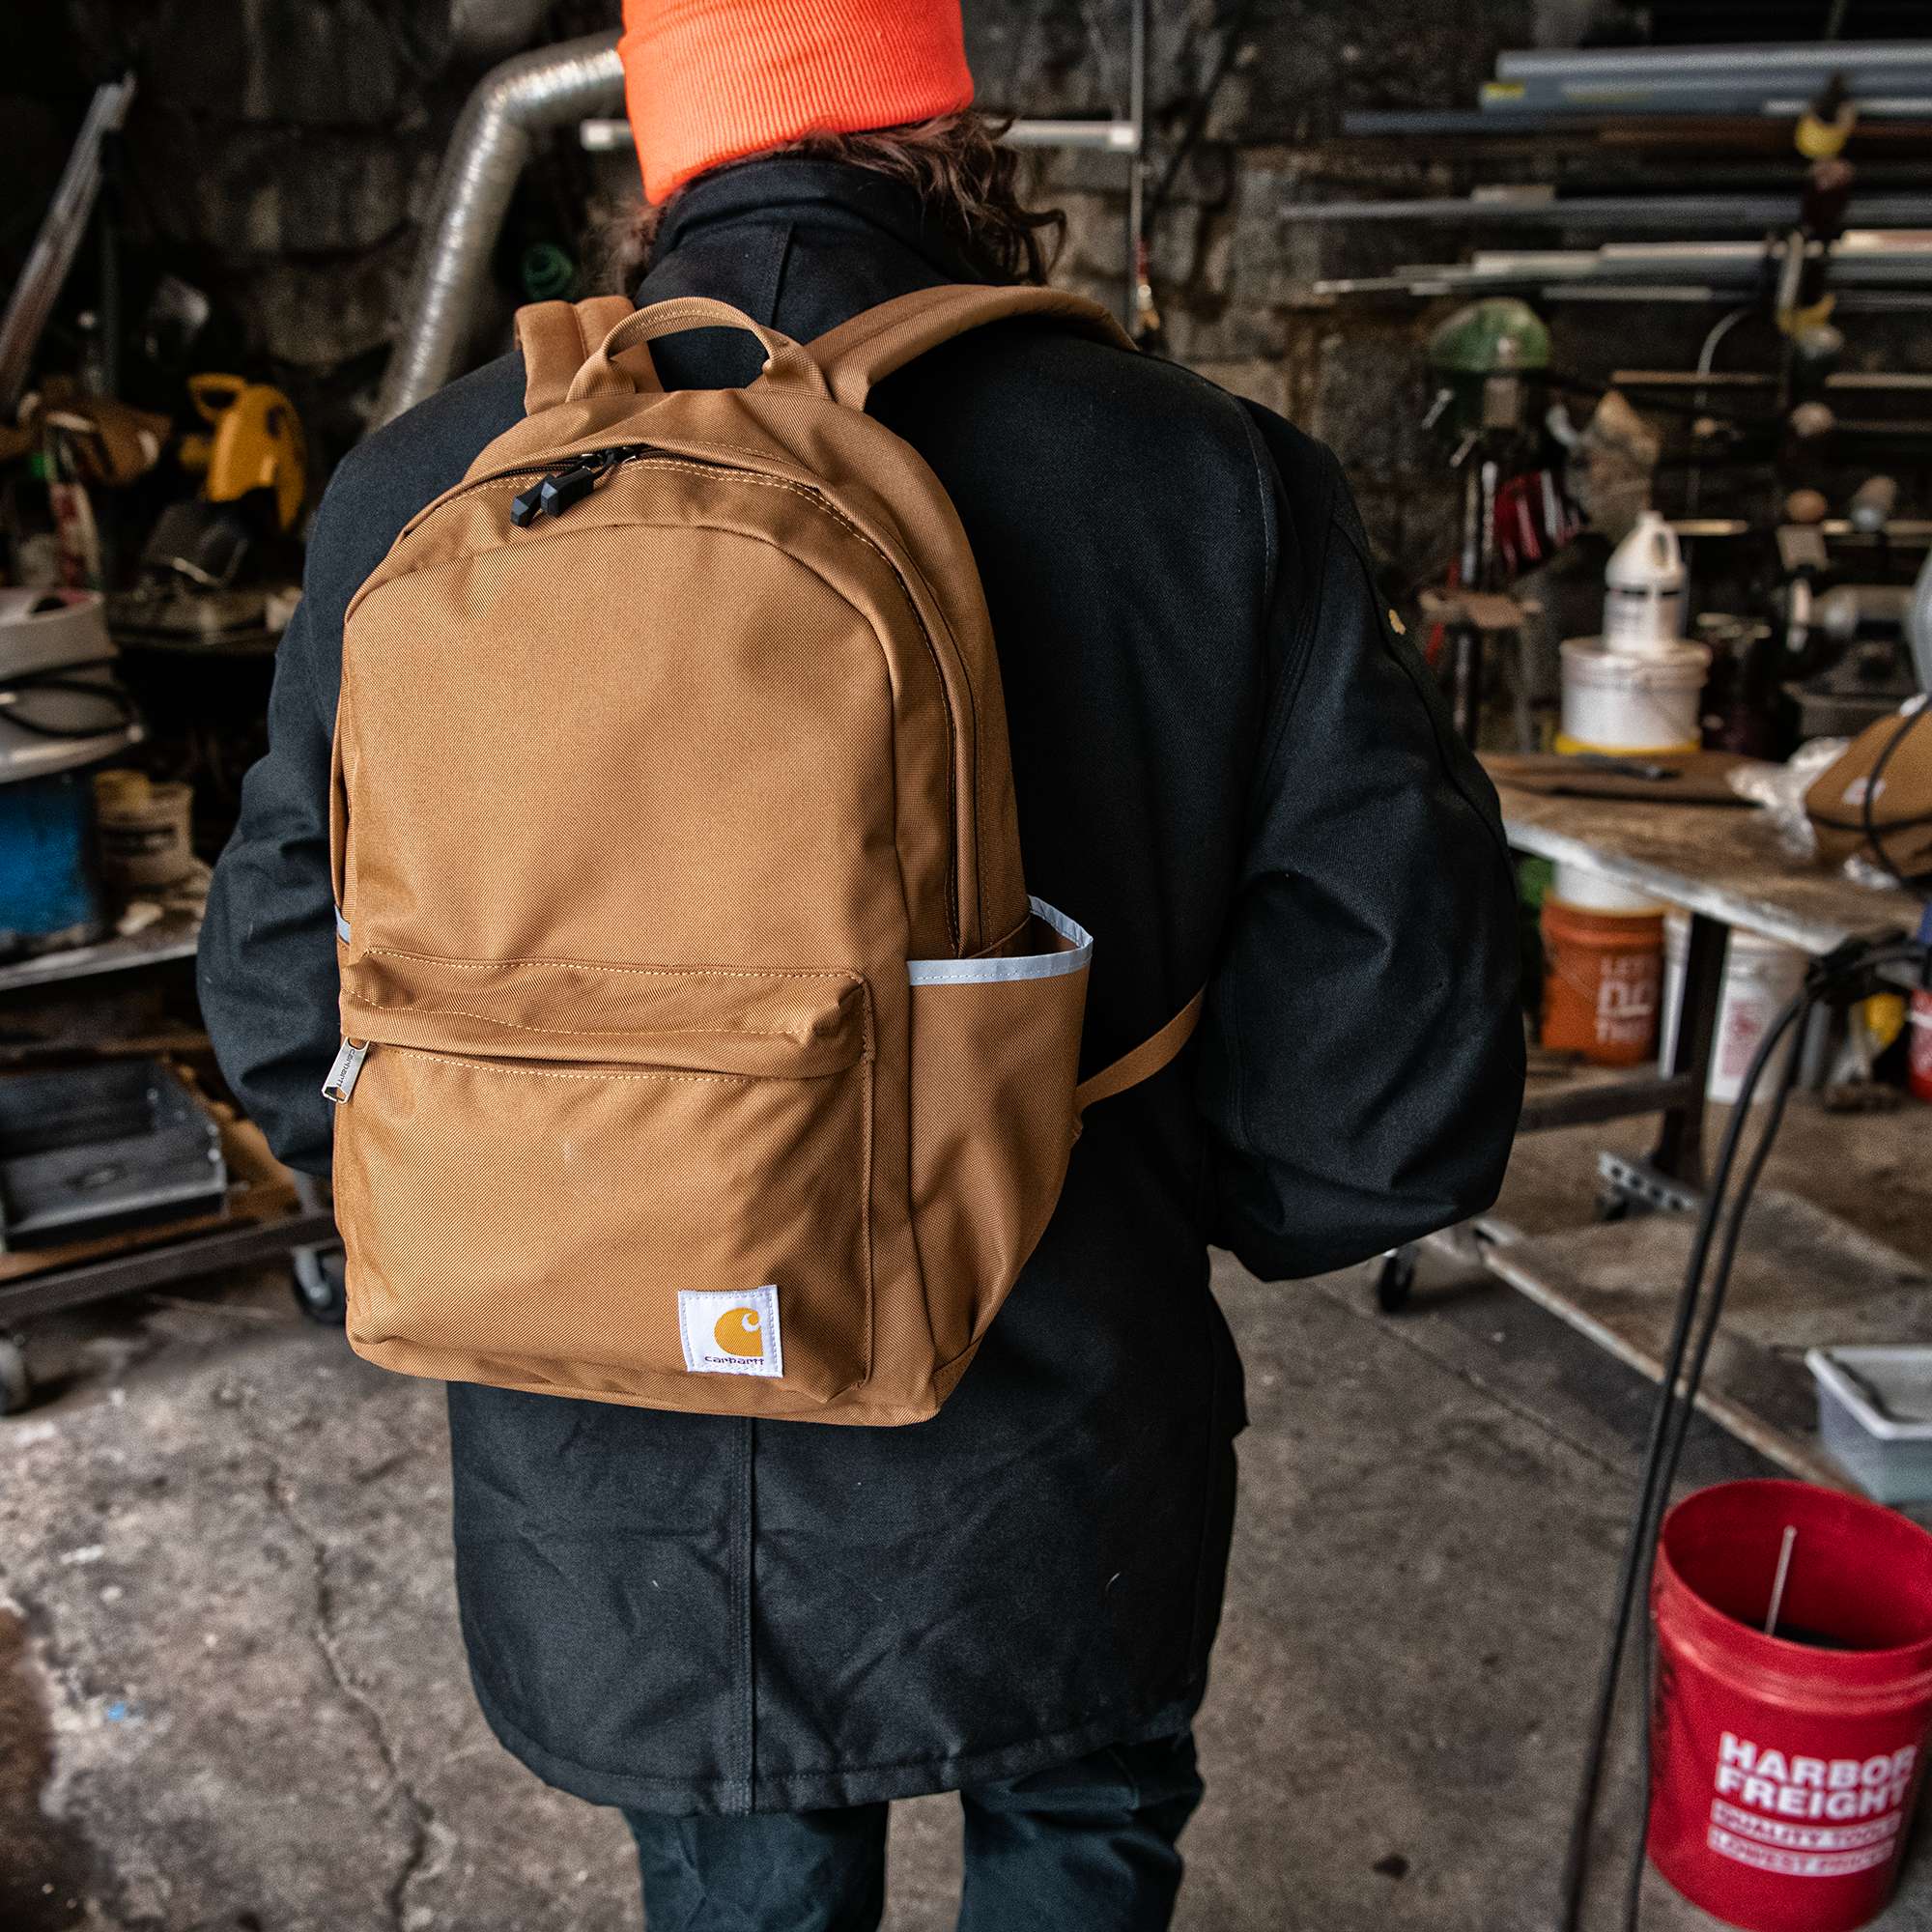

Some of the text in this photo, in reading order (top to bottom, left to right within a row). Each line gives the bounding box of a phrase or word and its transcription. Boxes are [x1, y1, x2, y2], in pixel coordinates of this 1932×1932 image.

[704, 1355, 765, 1366] carhartt
[1719, 1730, 1916, 1788] HARBOR
[1715, 1762, 1910, 1820] FREIGHT
